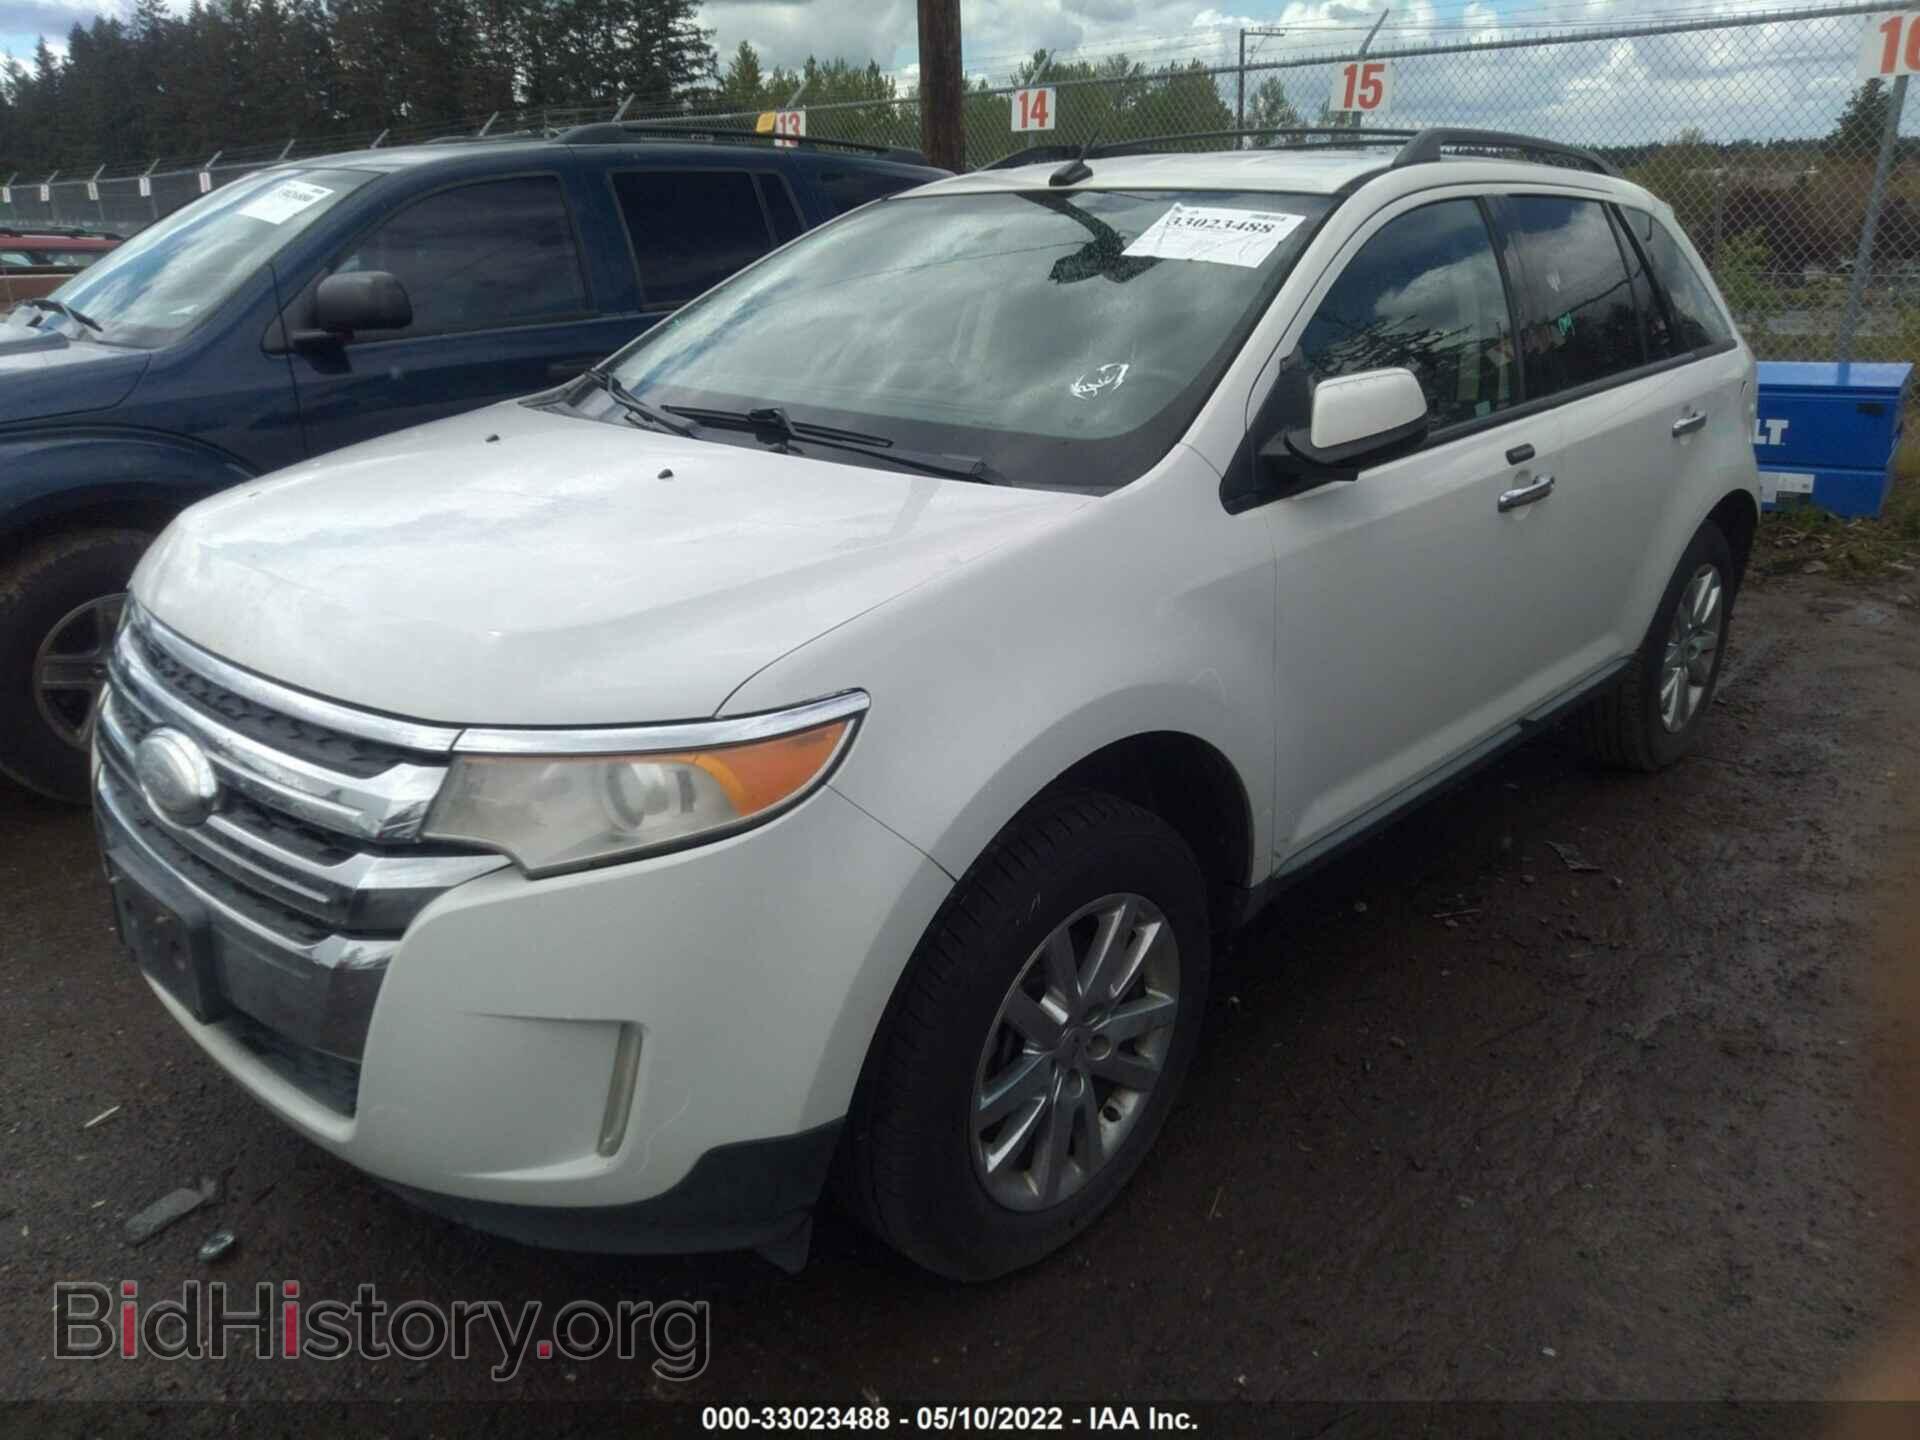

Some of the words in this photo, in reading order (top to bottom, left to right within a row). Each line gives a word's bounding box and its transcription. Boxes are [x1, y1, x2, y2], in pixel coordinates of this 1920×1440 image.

[1343, 63, 1385, 110] 15
[1018, 89, 1049, 129] 14
[779, 111, 801, 145] 13
[1166, 216, 1276, 234] 33023488
